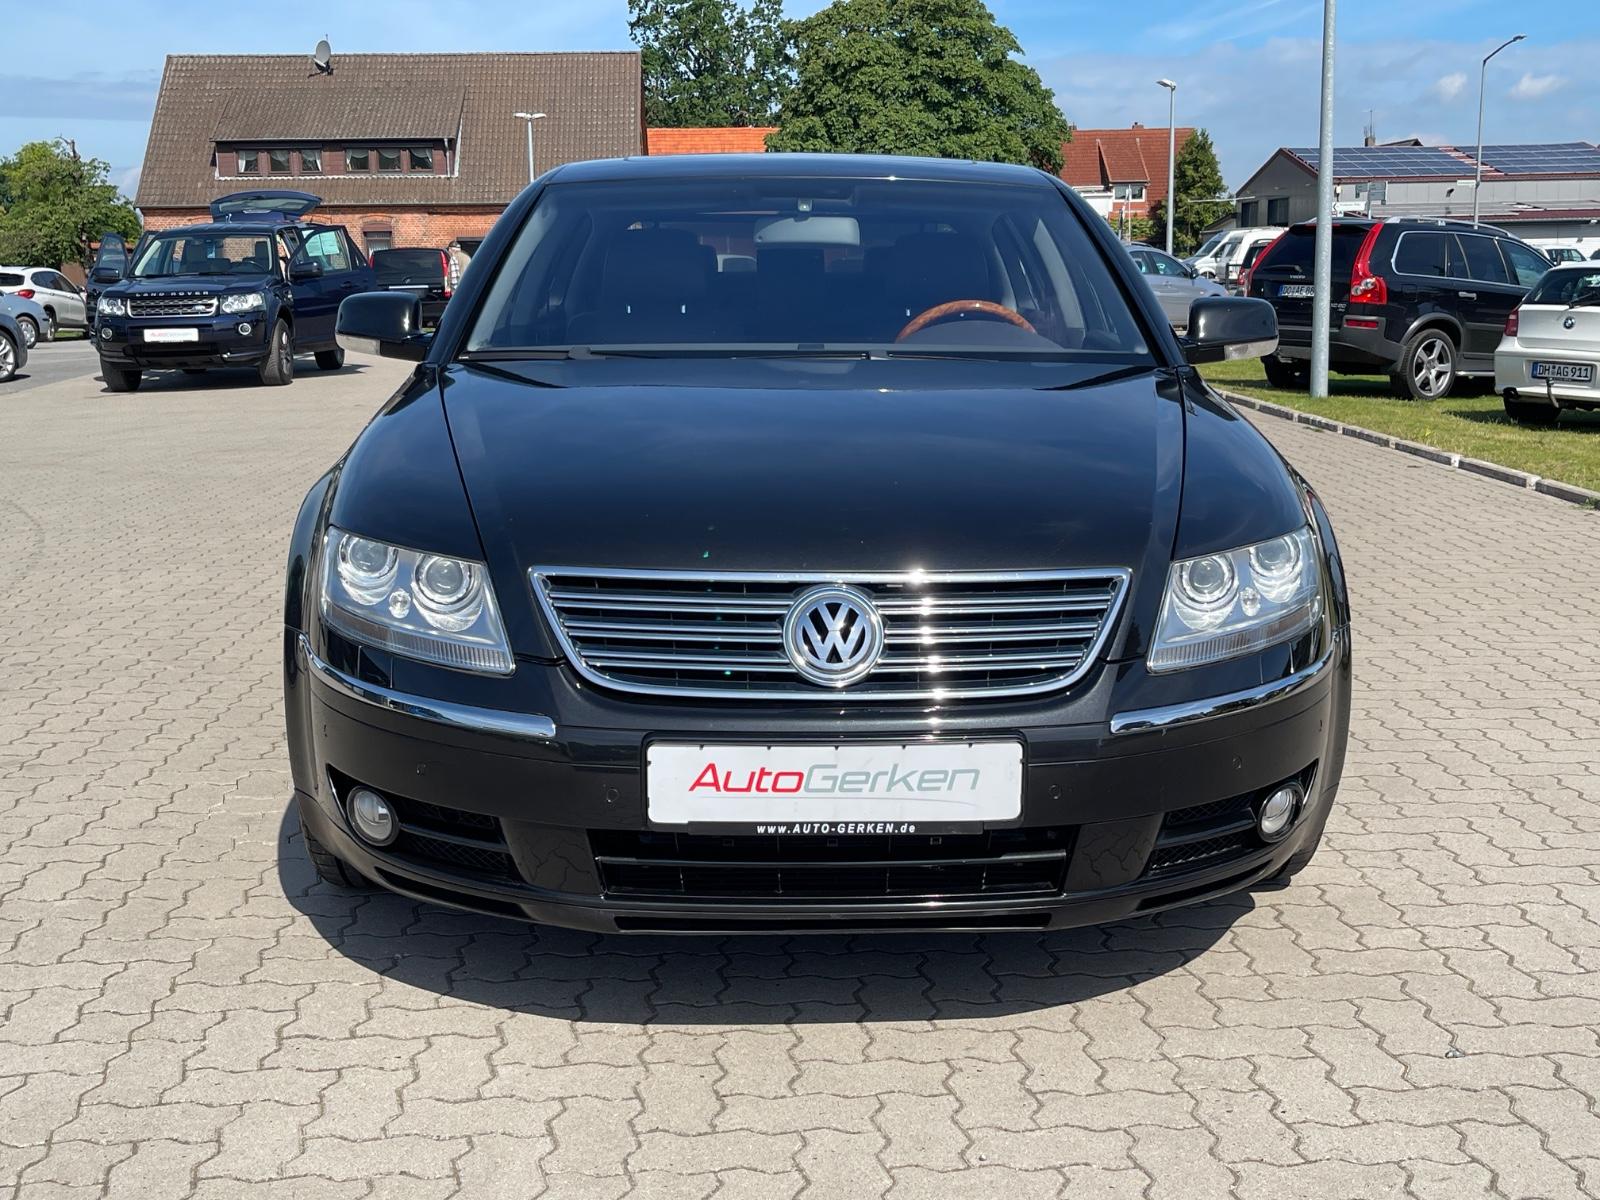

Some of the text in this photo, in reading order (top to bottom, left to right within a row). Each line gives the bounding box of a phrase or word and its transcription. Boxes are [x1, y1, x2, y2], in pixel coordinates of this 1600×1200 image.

[1538, 364, 1589, 378] DH AG 911
[688, 762, 981, 793] AutoGerken
[756, 823, 916, 834] www.AUTO-GERKEN.de
